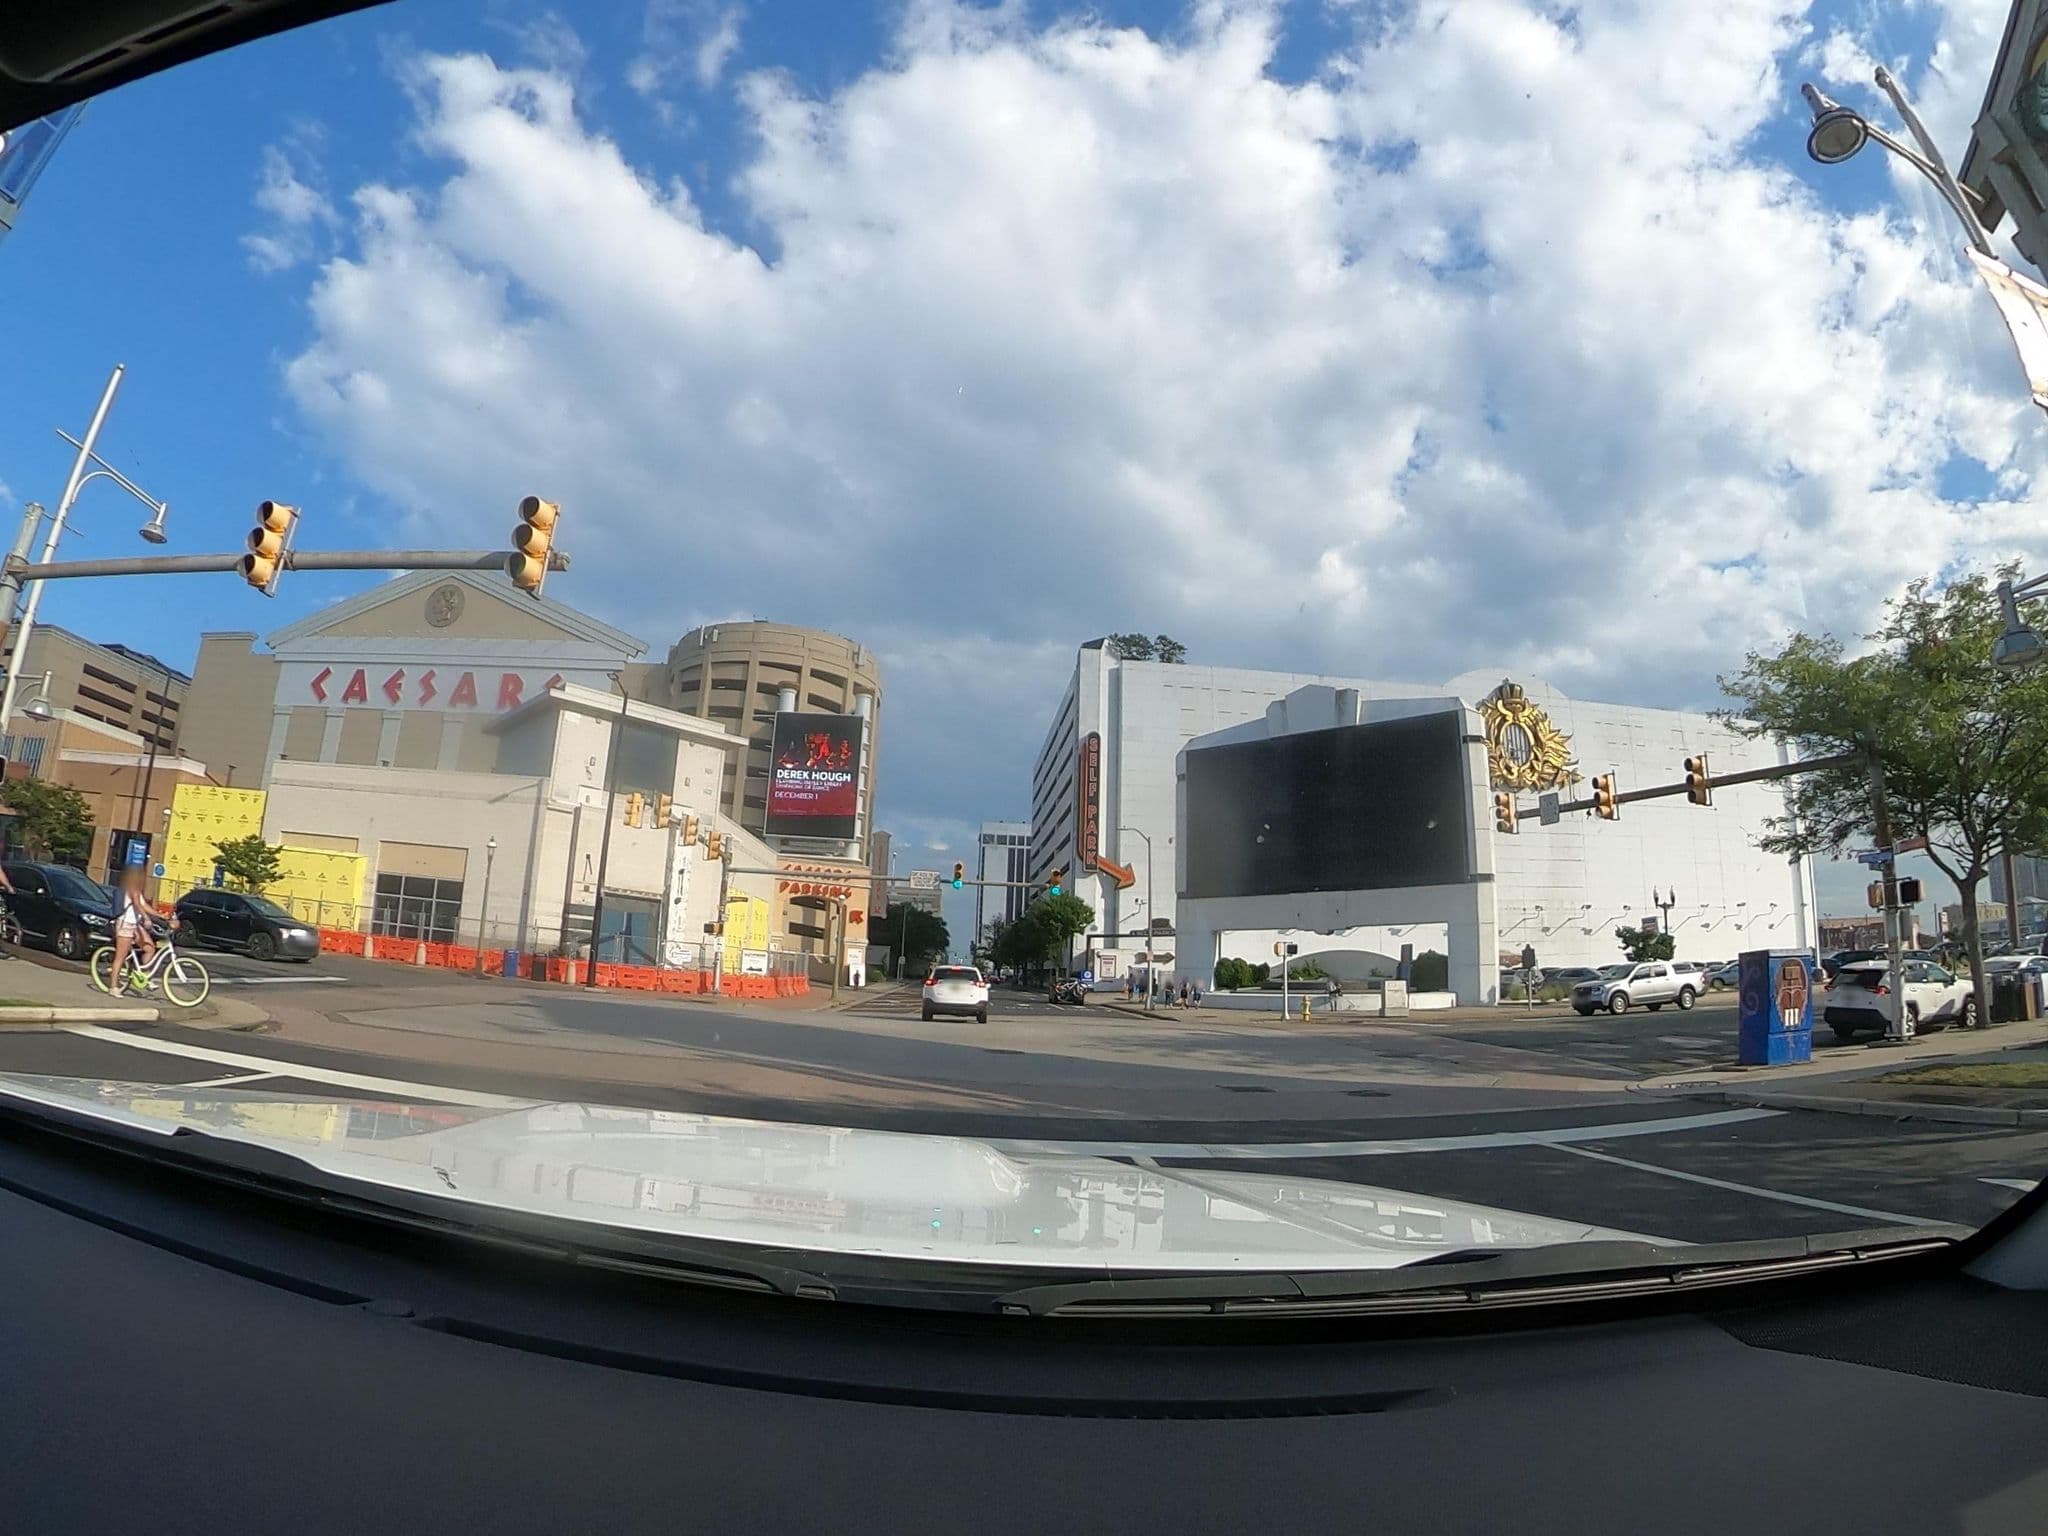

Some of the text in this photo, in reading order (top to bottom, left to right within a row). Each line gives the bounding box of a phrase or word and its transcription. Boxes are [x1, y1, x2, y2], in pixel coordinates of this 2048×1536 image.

[776, 769, 851, 782] DEREK HOUGH
[774, 791, 814, 800] DECEMBER
[1087, 738, 1098, 864] SELF PARK
[779, 881, 852, 898] PARKING
